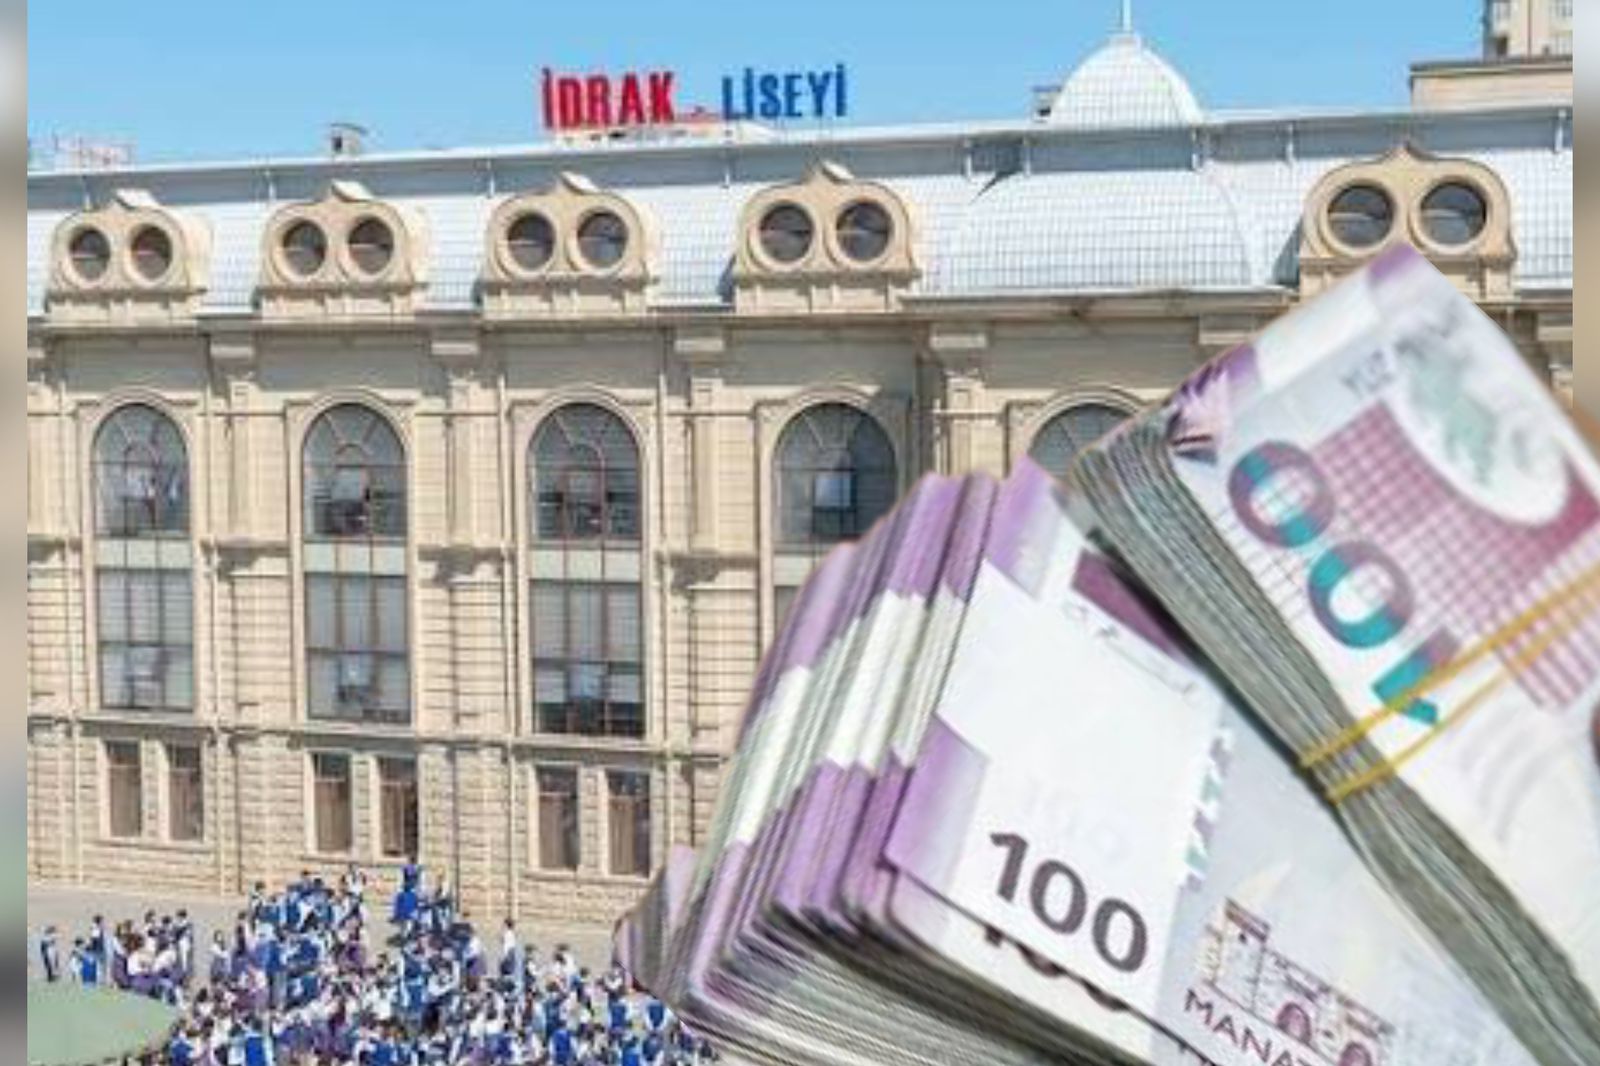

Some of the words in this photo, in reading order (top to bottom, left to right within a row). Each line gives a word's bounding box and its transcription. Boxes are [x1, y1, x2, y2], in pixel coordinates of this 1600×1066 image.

[542, 67, 676, 130] İDRAK
[721, 63, 848, 121] LİSEYİ
[1227, 440, 1464, 725] 100
[989, 832, 1148, 973] 100
[1184, 988, 1312, 1066] MANA
